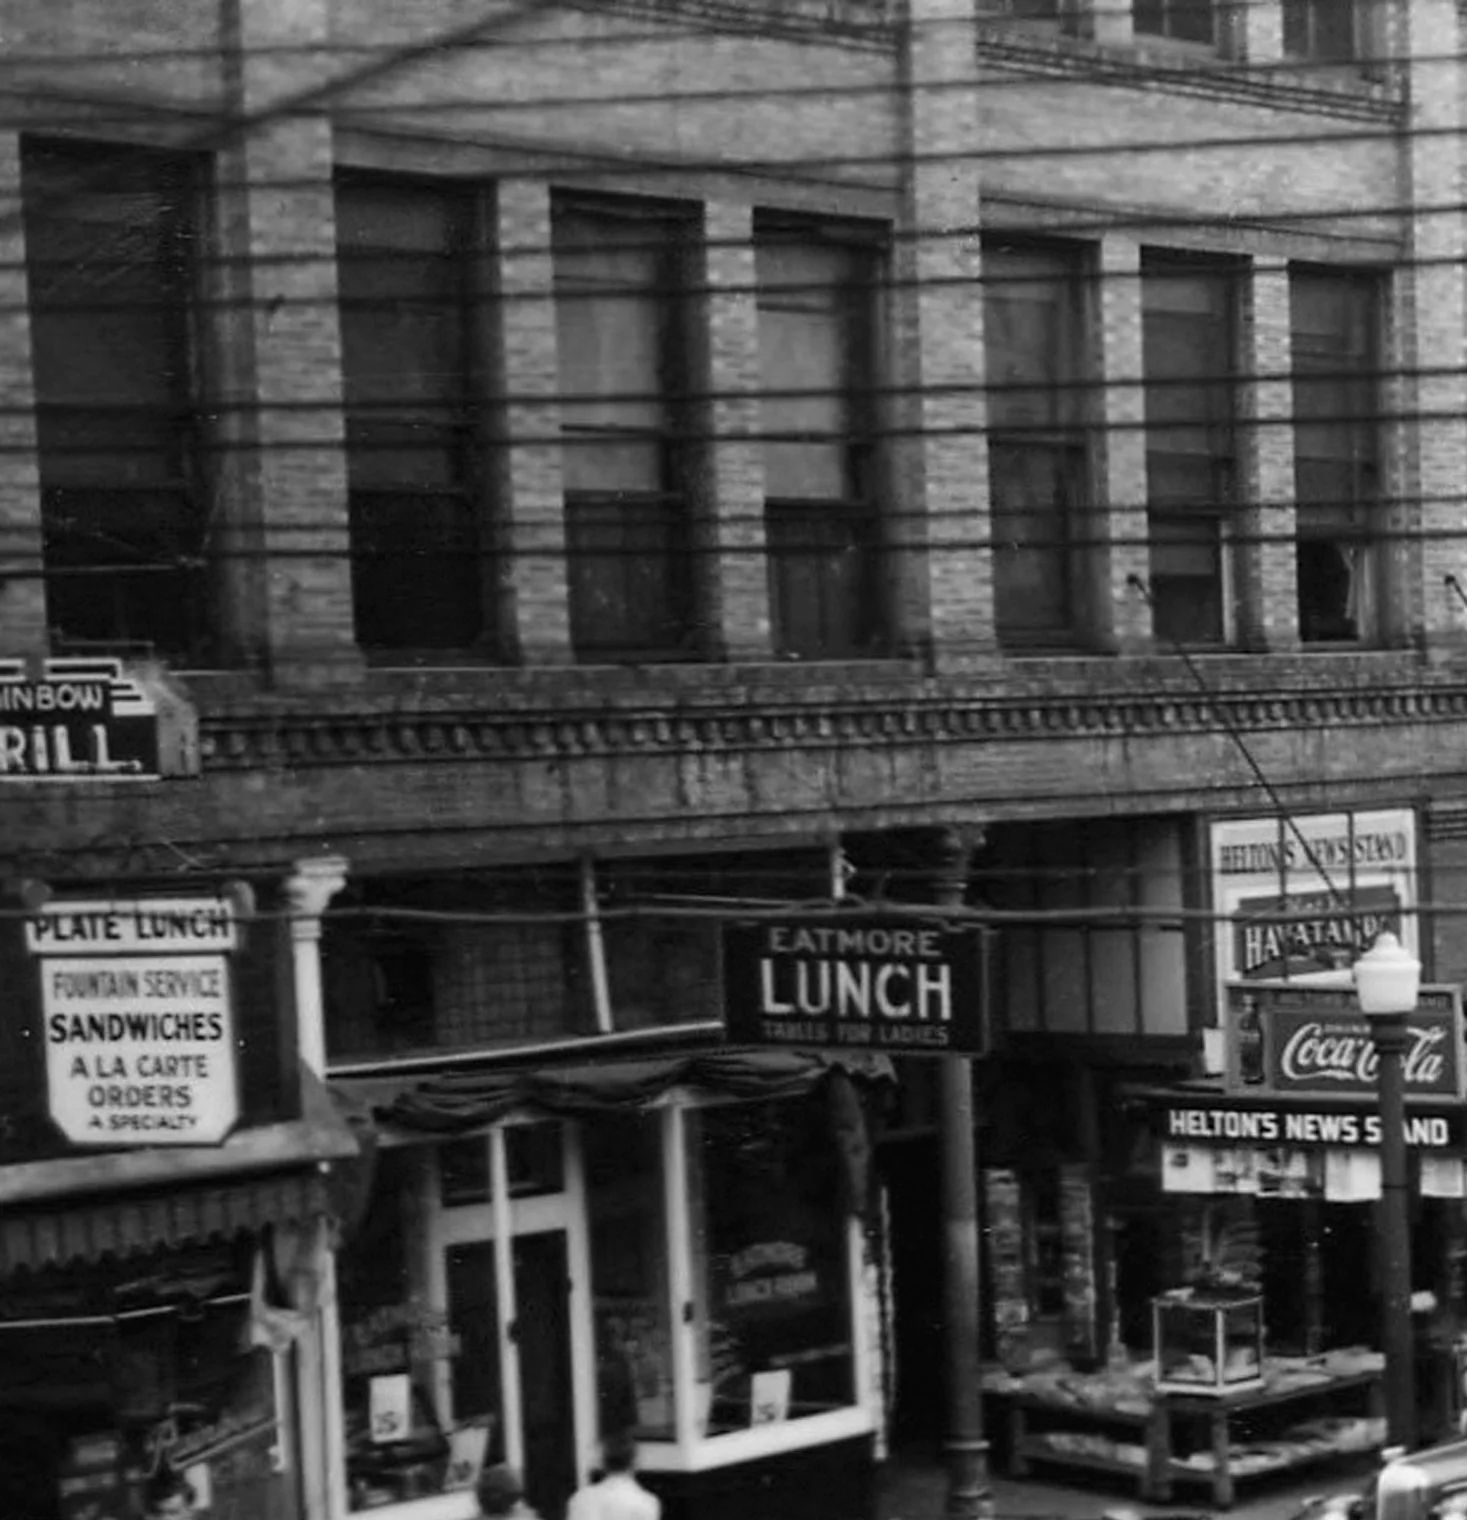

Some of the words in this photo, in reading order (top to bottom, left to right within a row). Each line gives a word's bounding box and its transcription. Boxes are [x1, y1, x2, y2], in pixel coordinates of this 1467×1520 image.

[1221, 840, 1294, 870] HELTONS
[33, 913, 121, 943] PLATE
[135, 908, 229, 940] LUNCH
[771, 927, 942, 956] EATMORE
[53, 970, 138, 1000] FOUNTAIN
[144, 969, 220, 999] SERVICE
[761, 958, 951, 1020] LUNCH
[49, 1011, 223, 1043] SANDWICHES
[71, 1055, 89, 1078] A
[99, 1054, 128, 1078] LA
[137, 1054, 209, 1079] CARTE
[1282, 1022, 1447, 1083] Coca-Cla
[88, 1085, 192, 1109] ORDERS
[105, 1114, 197, 1131] SPECIALTY
[1170, 1108, 1279, 1140] HELTON'S
[1286, 1113, 1360, 1141] NEWS
[1364, 1115, 1449, 1145] SAND
